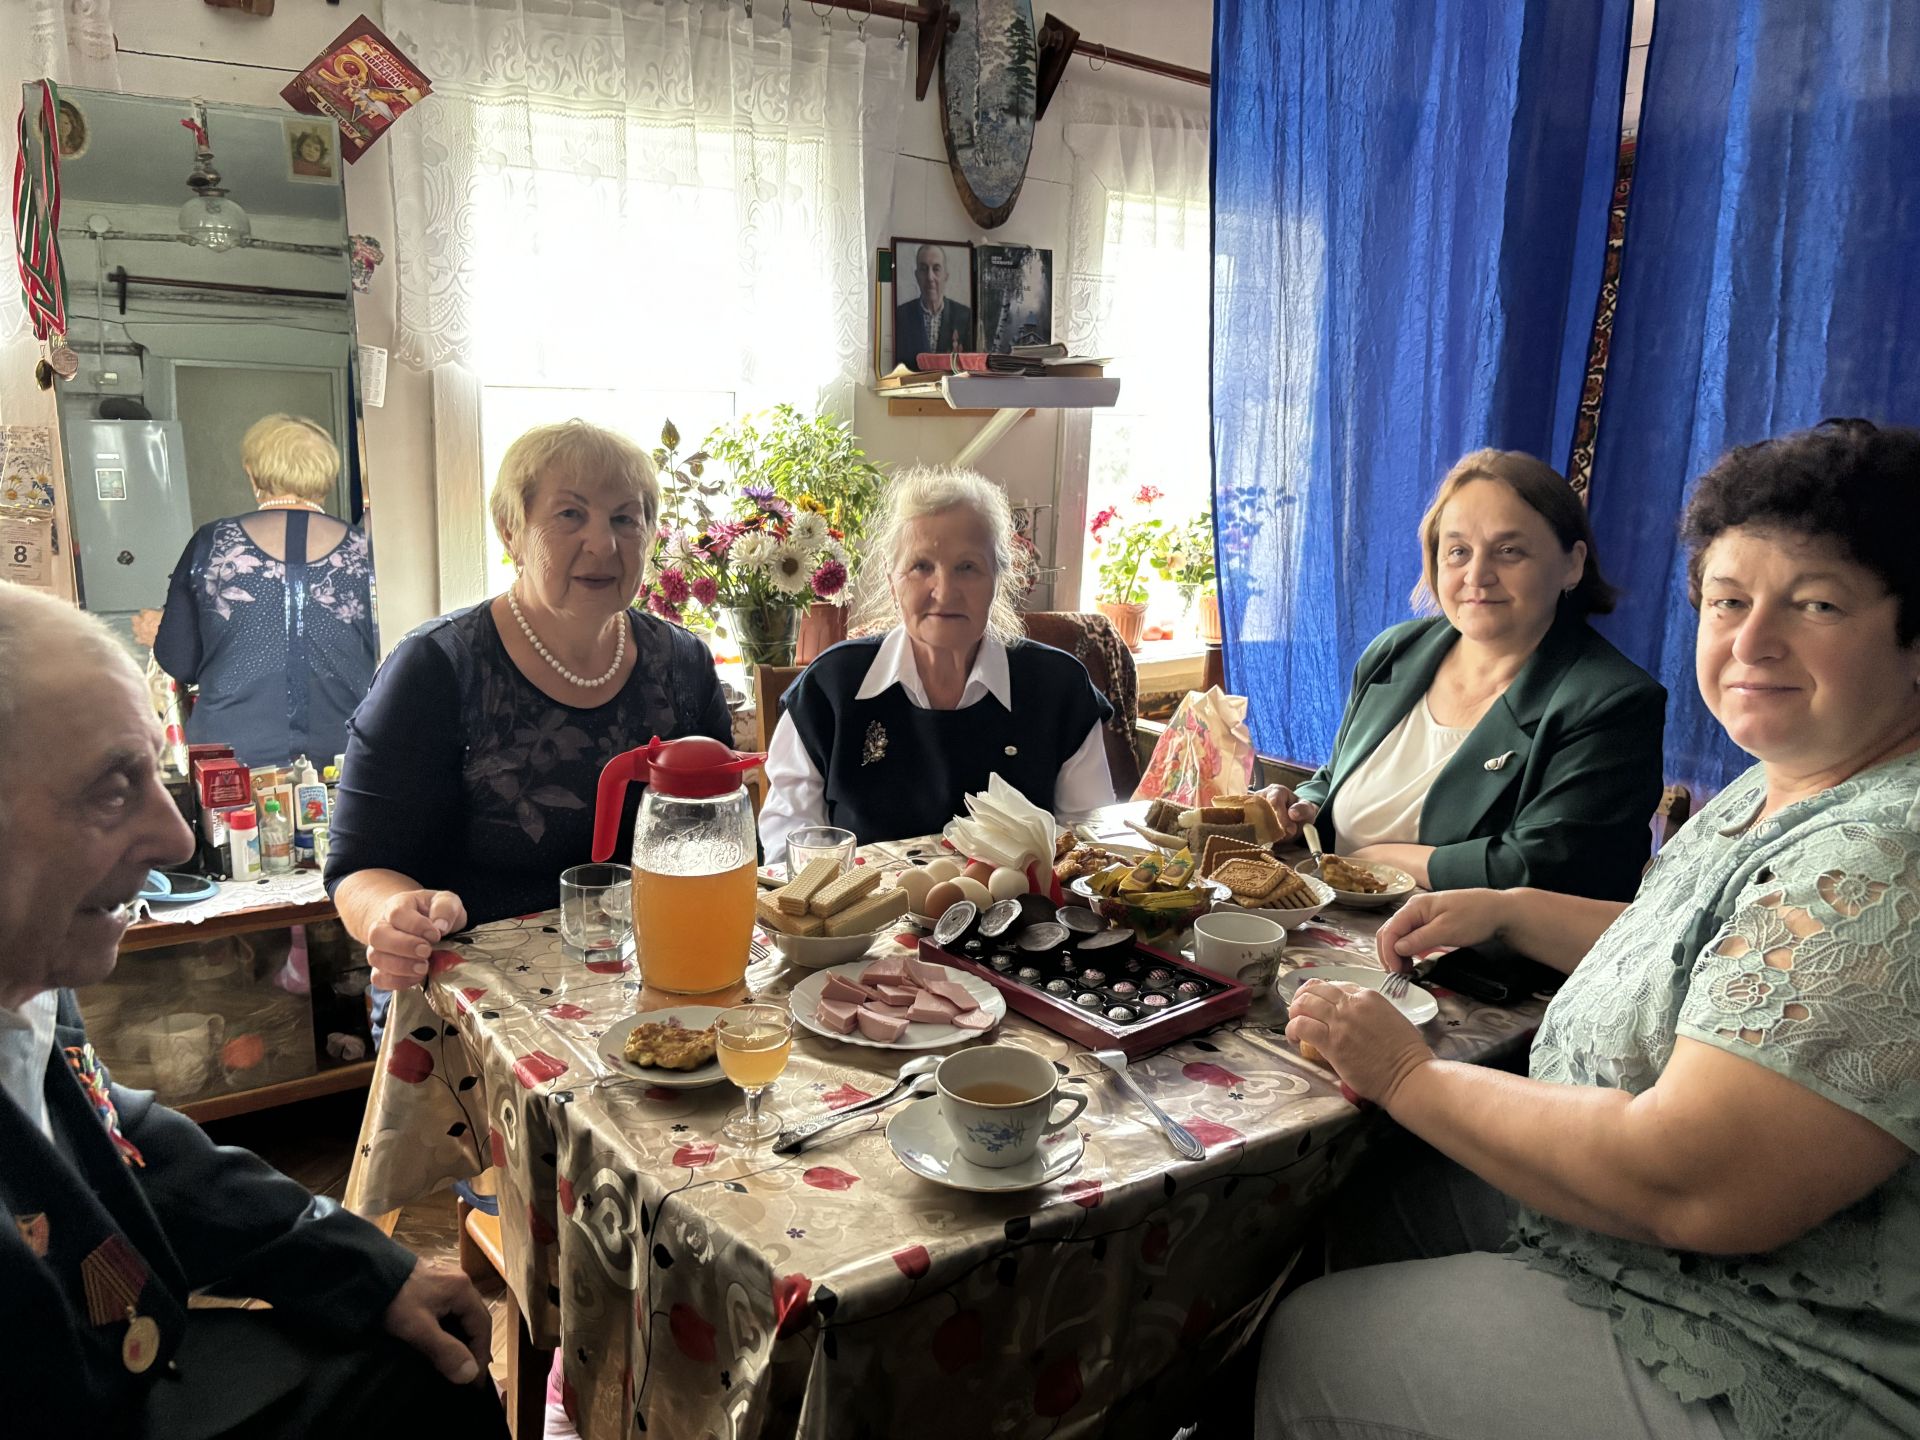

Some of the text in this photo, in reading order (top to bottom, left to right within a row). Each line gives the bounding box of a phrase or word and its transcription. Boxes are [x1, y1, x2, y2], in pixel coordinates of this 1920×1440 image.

[318, 54, 379, 120] 9 МАЯ
[13, 545, 27, 563] 8
